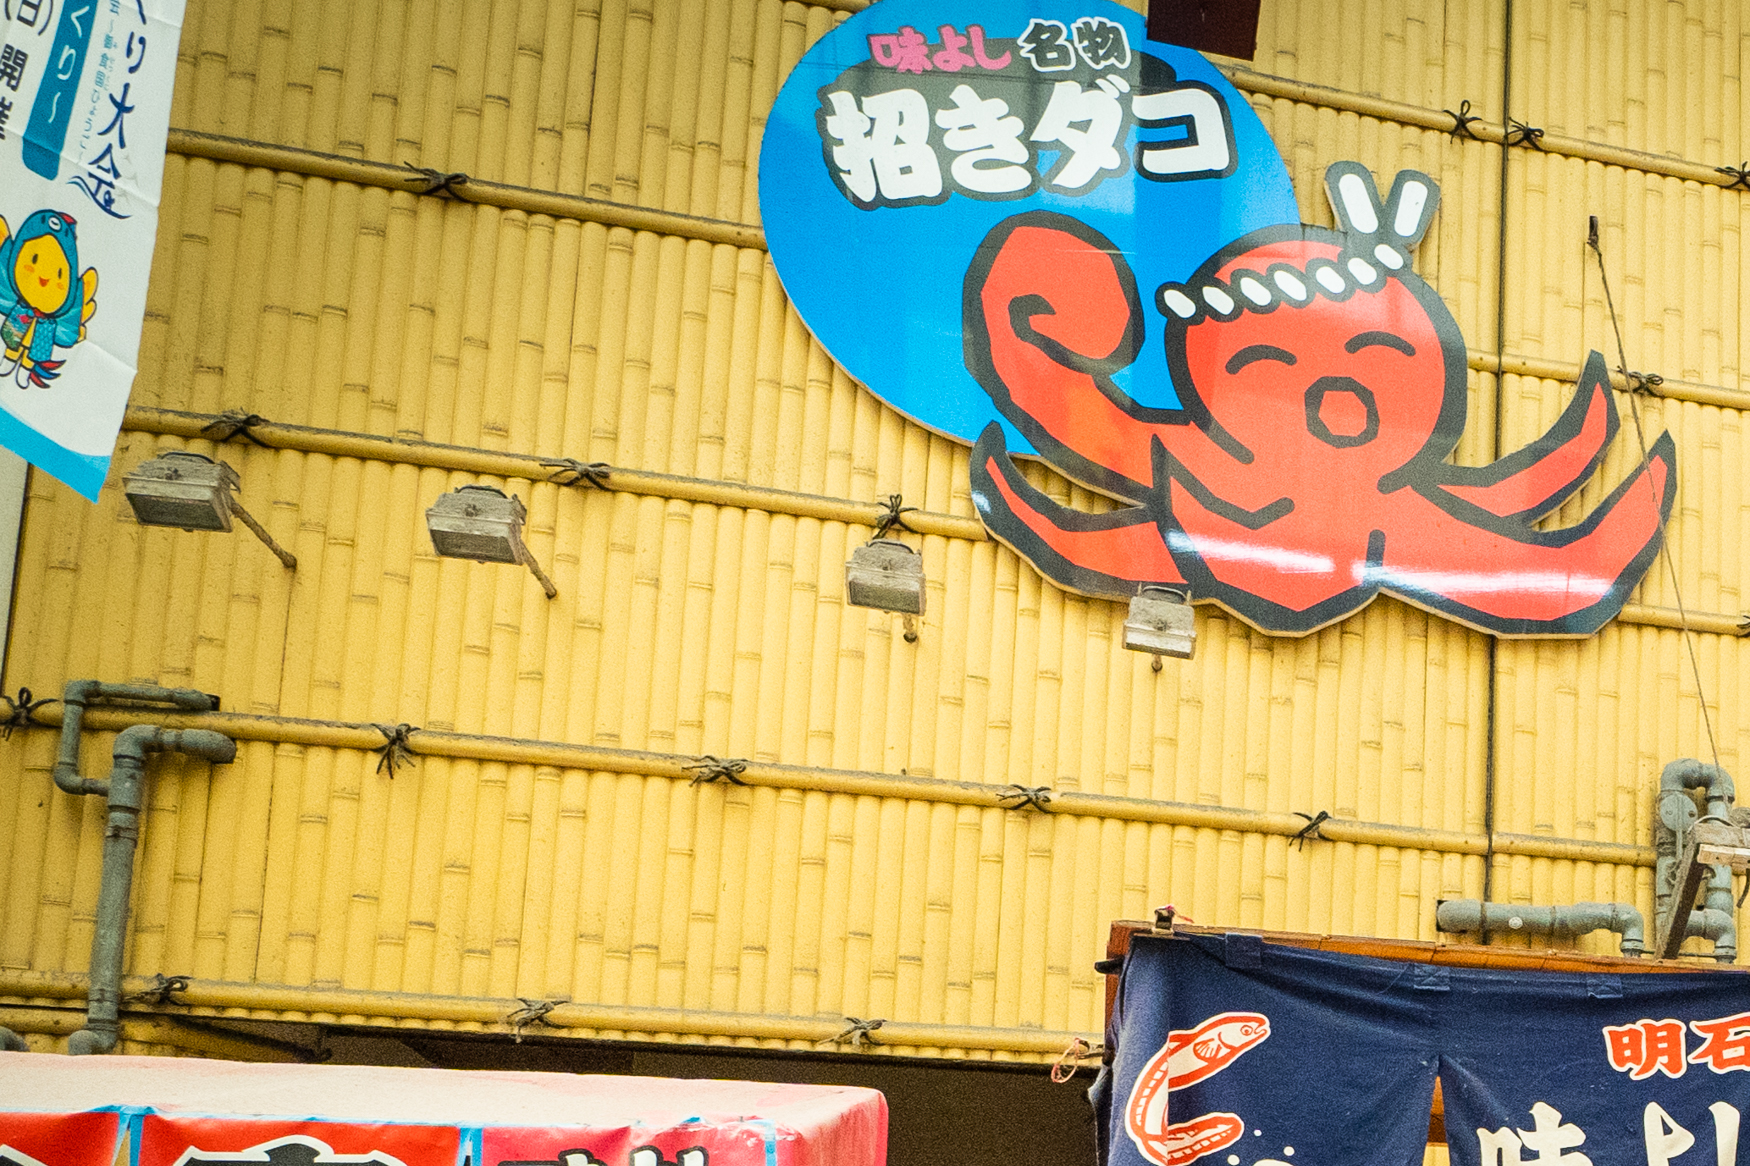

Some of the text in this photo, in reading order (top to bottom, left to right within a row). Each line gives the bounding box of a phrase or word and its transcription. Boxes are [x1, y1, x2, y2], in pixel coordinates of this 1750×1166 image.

[866, 16, 1131, 74] 味よし 名物
[824, 75, 1230, 203] 招きダコ
